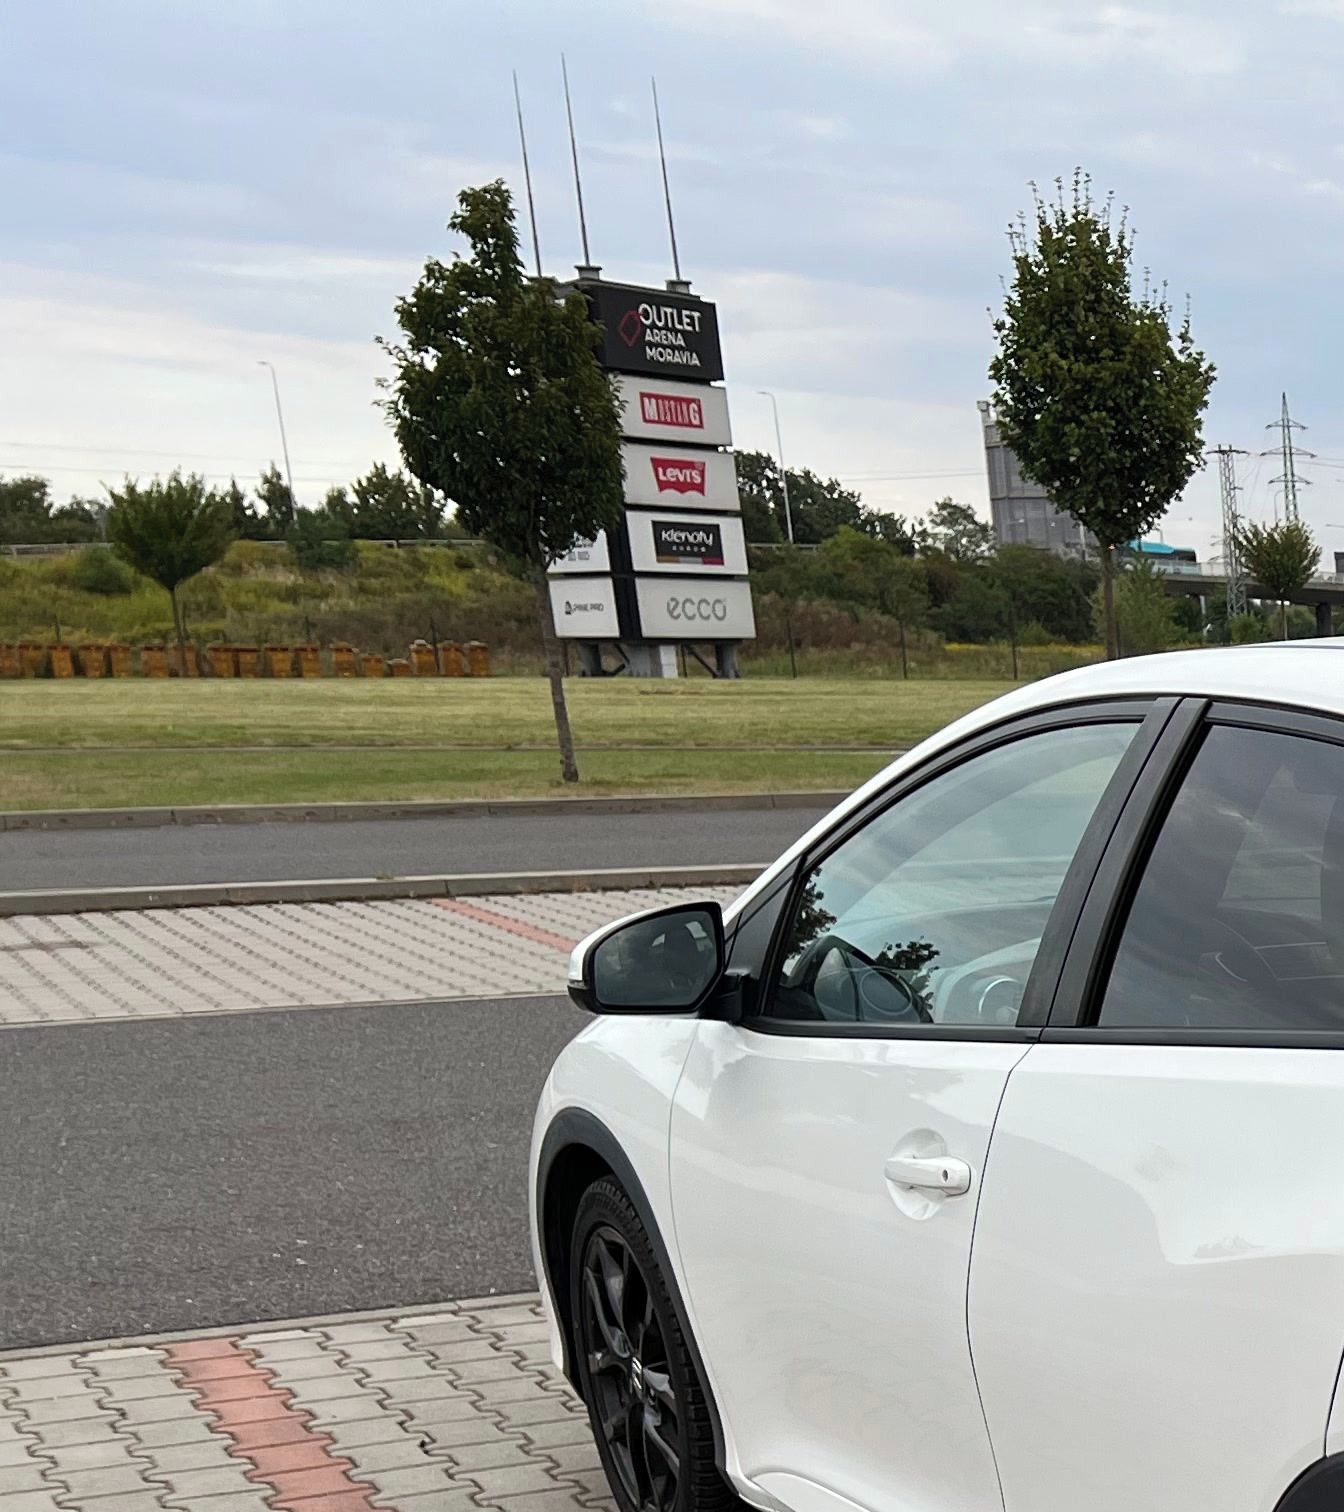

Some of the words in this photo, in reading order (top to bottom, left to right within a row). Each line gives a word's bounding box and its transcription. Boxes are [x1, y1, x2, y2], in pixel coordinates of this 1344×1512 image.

[638, 303, 701, 332] OUTLET
[644, 328, 686, 347] ARENA
[645, 345, 701, 366] MORAVIA
[642, 396, 701, 426] MUSTANG
[666, 597, 727, 621] ecco
